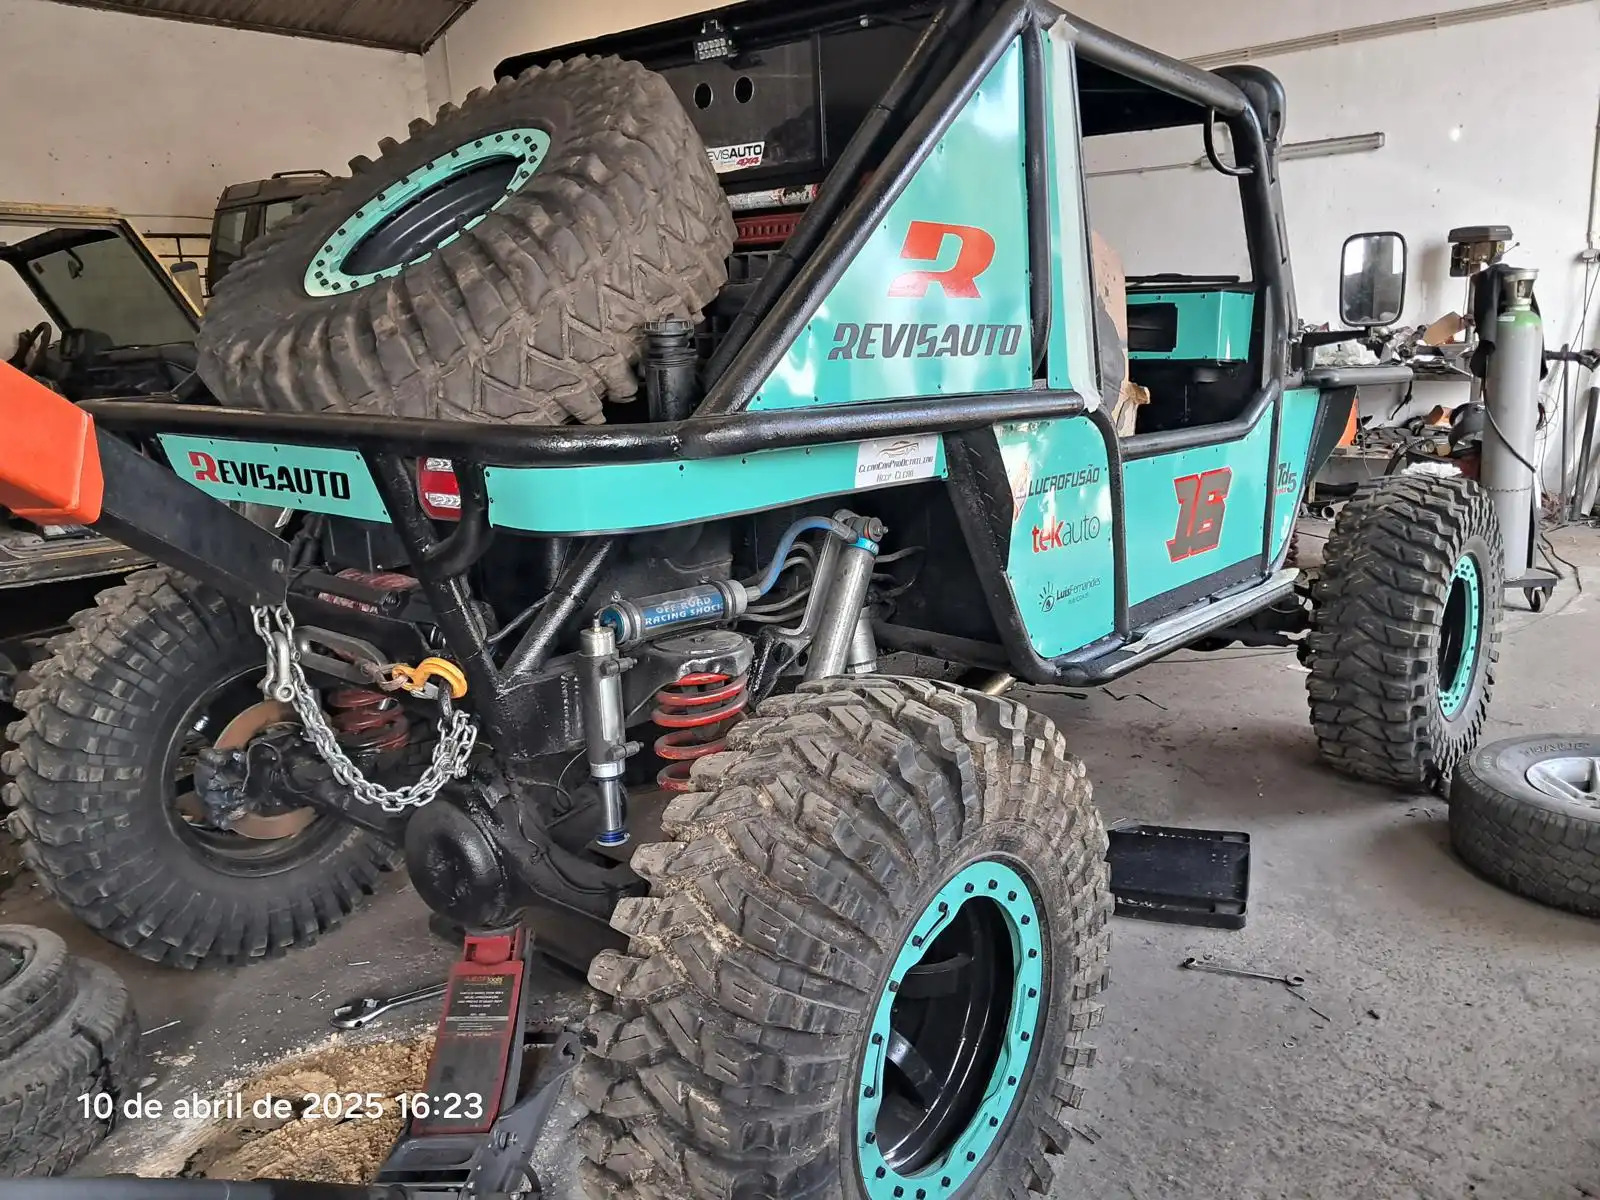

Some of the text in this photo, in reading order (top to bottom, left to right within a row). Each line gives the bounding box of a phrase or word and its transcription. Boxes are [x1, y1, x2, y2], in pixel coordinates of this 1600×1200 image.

[827, 322, 1022, 361] REVISAUTO
[187, 451, 351, 500] REVISAUTO
[1165, 465, 1232, 564] 16
[645, 610, 687, 626] RACING
